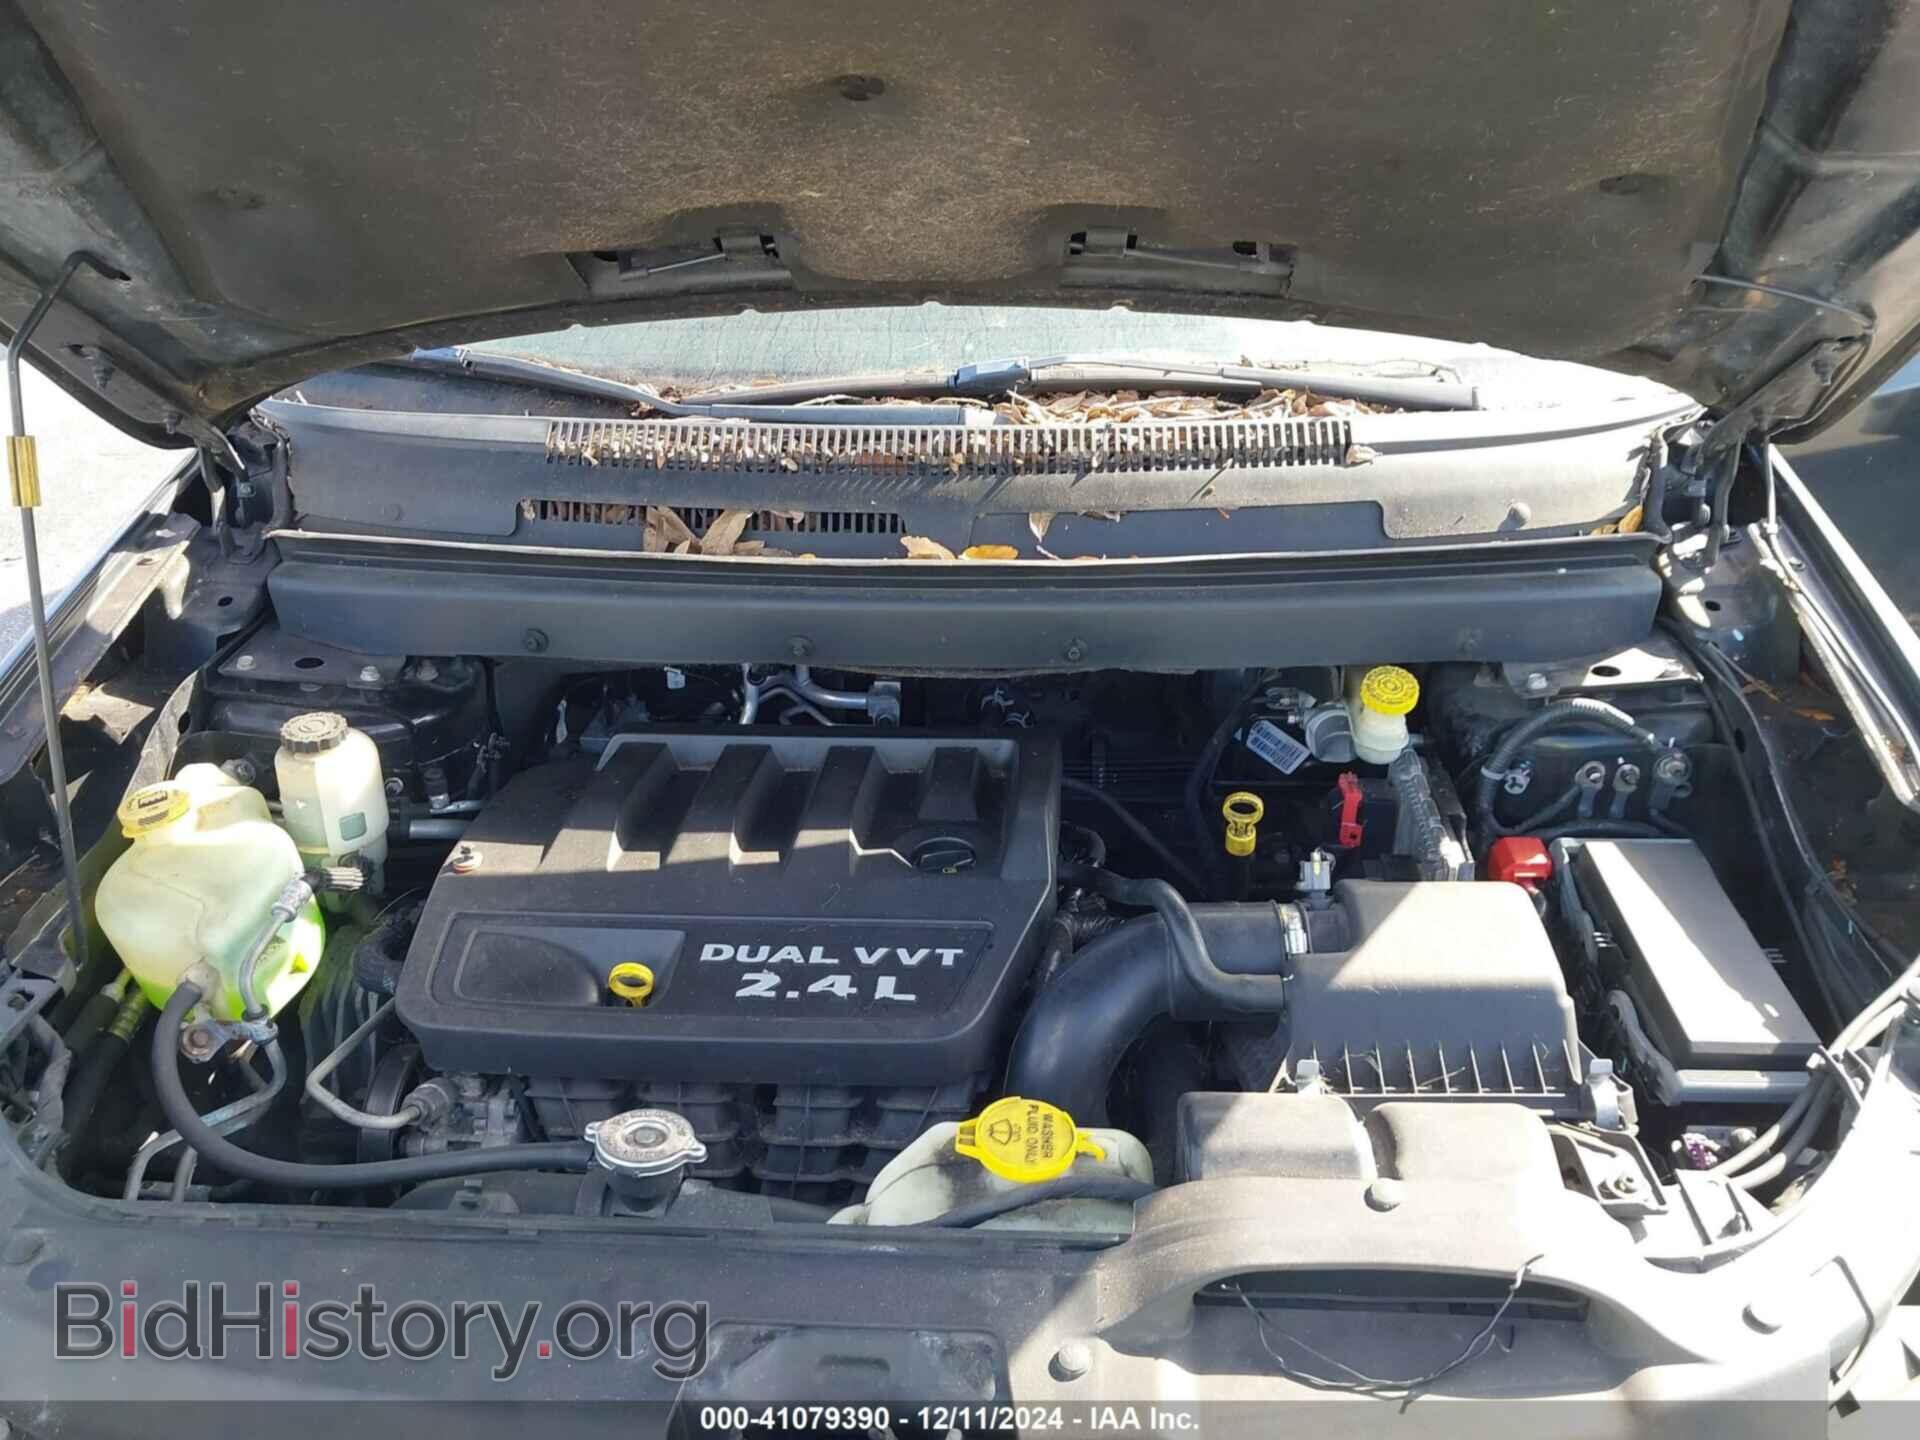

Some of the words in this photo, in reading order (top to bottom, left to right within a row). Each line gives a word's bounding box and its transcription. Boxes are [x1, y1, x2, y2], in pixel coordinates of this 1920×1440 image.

[700, 943, 839, 964] DUAL
[854, 947, 964, 966] VVT
[1026, 1103, 1040, 1134] FLUID
[1024, 1136, 1040, 1164] ONLY
[1041, 1112, 1054, 1159] WASHER
